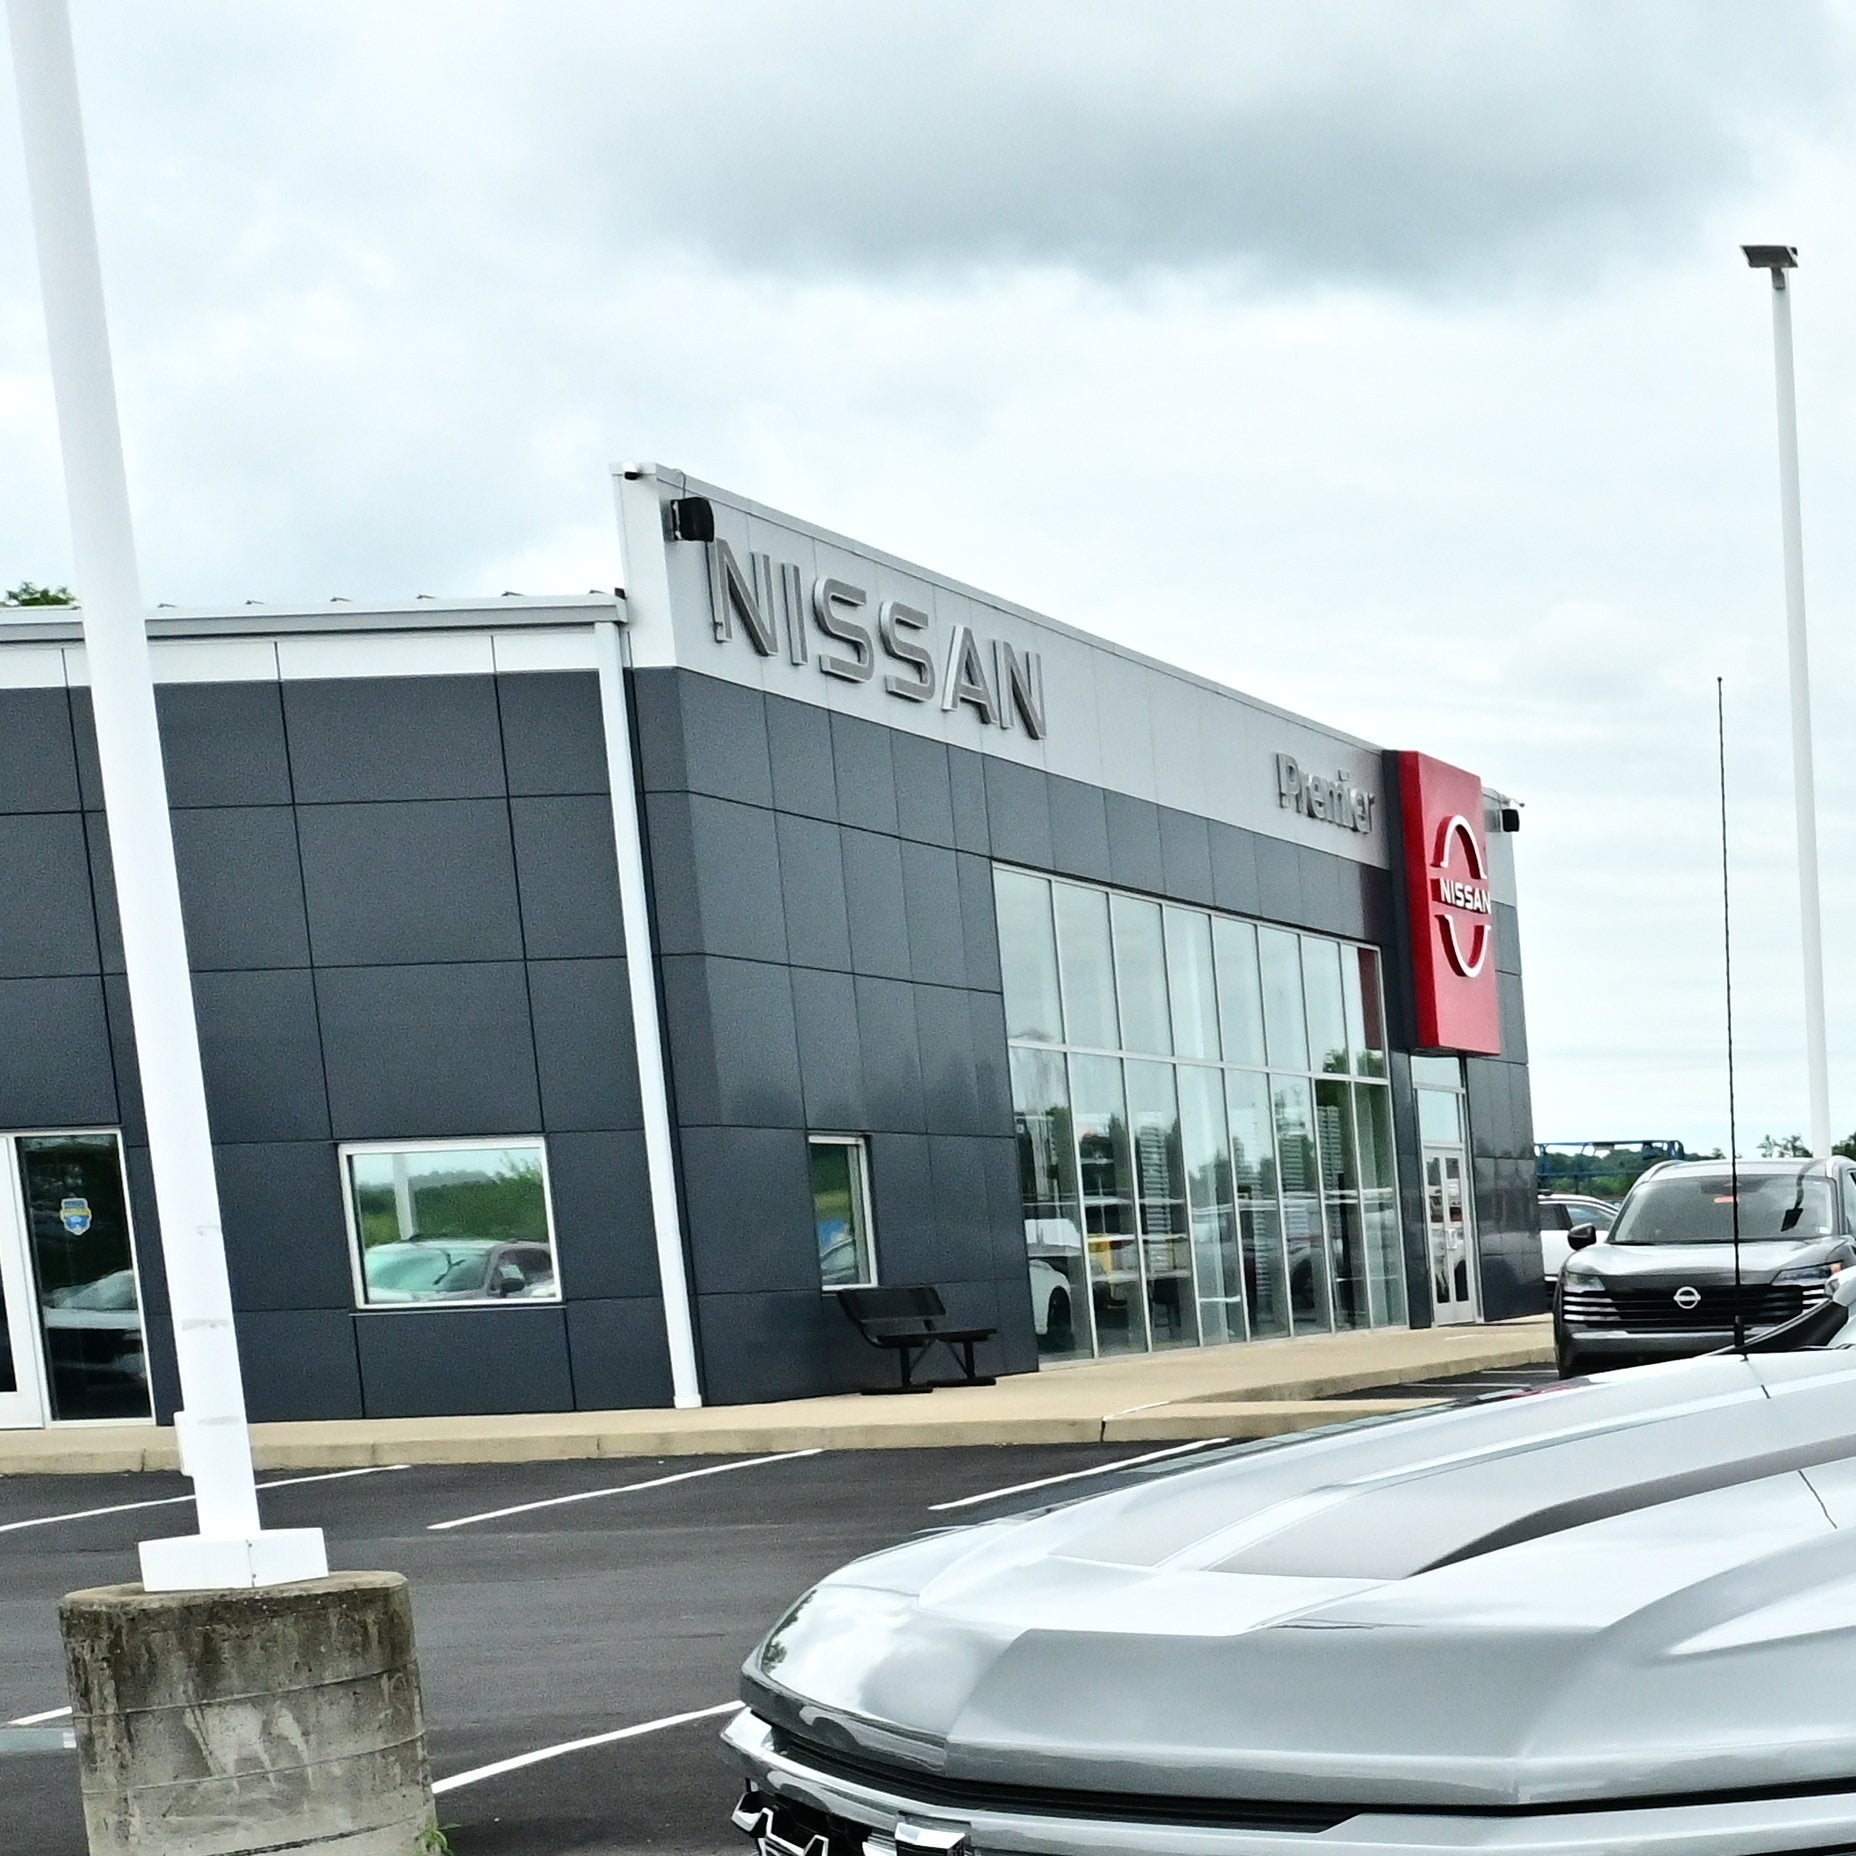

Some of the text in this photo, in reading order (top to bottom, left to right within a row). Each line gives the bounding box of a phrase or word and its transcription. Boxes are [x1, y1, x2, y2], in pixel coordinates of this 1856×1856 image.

[705, 536, 1047, 741] NISSAN
[1276, 753, 1375, 834] Premier
[1438, 877, 1492, 915] NISSAN
